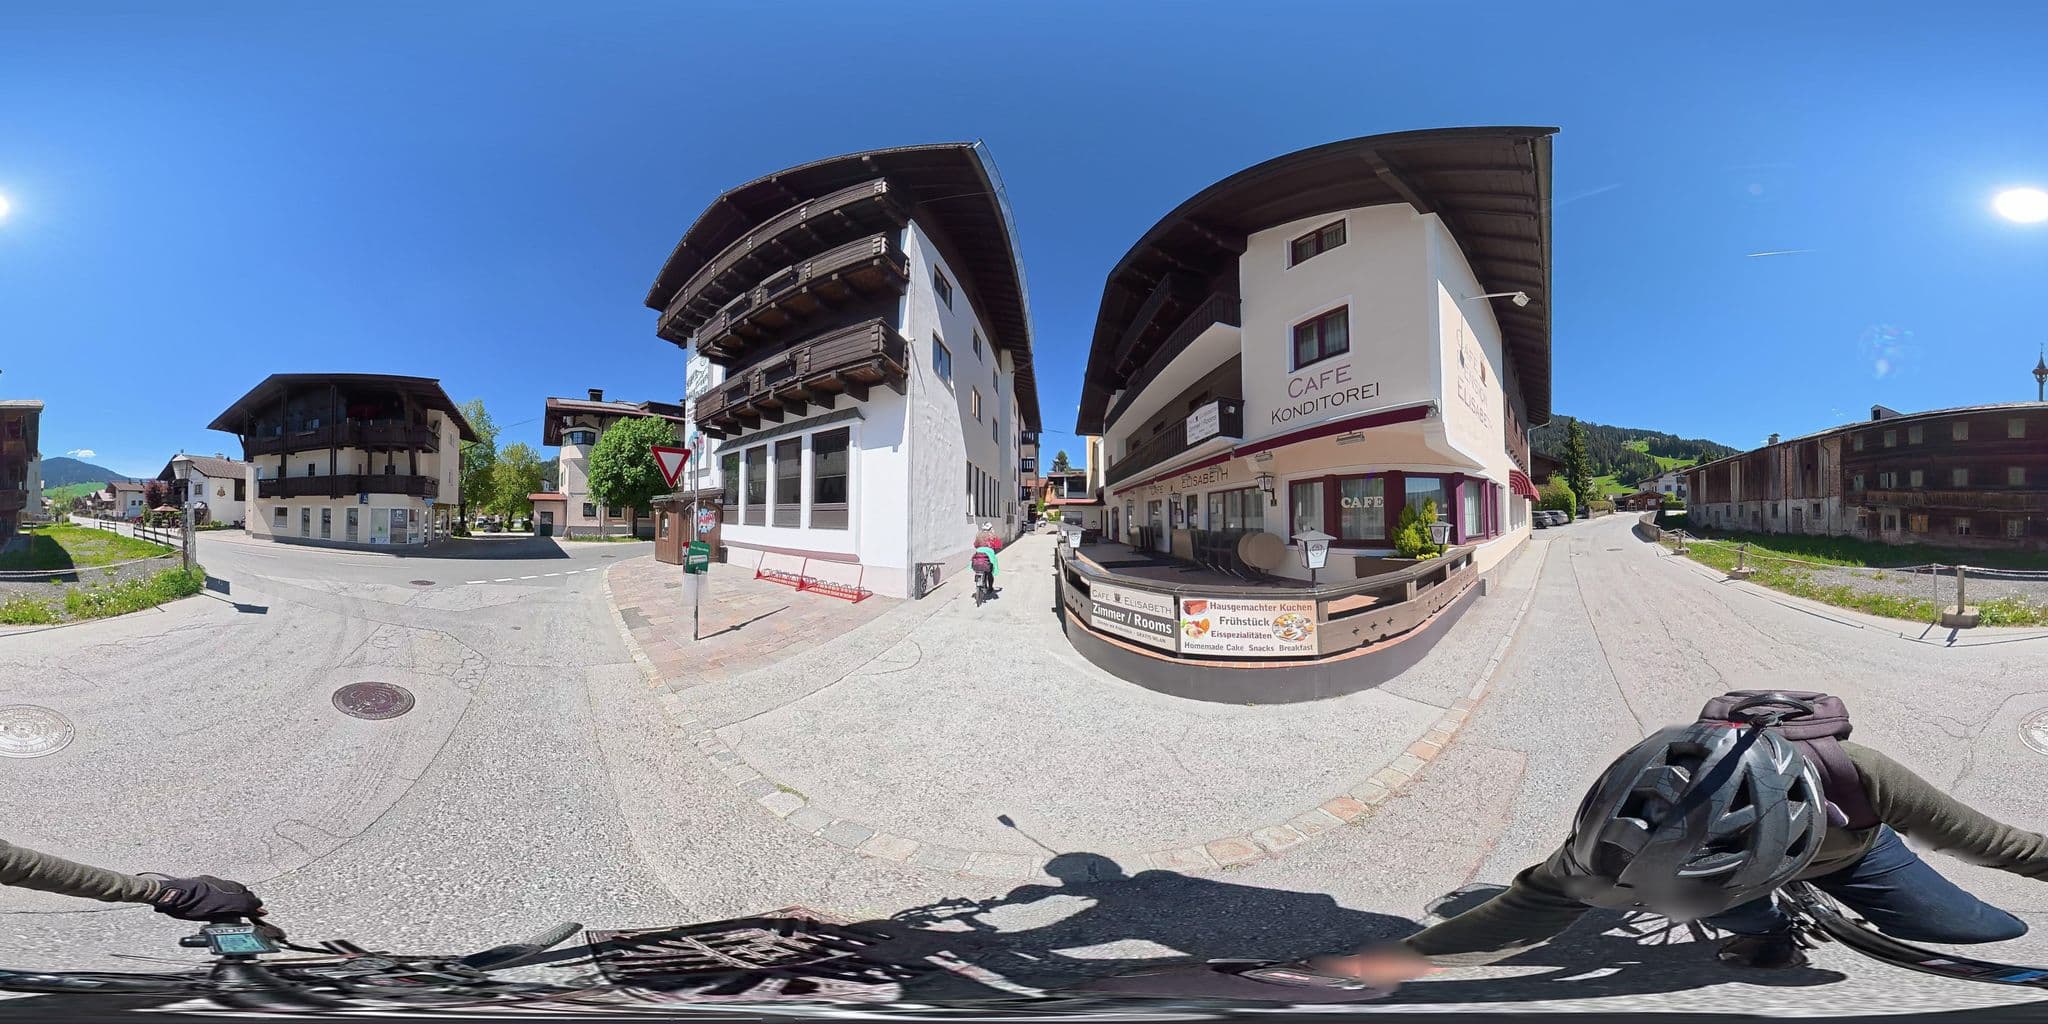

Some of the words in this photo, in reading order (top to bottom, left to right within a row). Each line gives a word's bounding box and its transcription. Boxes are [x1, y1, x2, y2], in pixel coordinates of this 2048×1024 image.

[1287, 364, 1352, 398] CAFE
[1271, 382, 1379, 424] KONDITOREI
[1341, 496, 1384, 509] CAFE
[1210, 601, 1276, 612] Hausgemachter
[1279, 602, 1312, 612] Kuchen
[1093, 602, 1126, 623] Zimmer
[1134, 613, 1172, 634] Rooms
[1219, 616, 1270, 627] Frühstück
[1211, 630, 1272, 640] Eisspezialitäten
[1184, 641, 1223, 651] Homemade
[1226, 643, 1244, 652] Cake
[1248, 644, 1274, 652] Snacks
[1279, 644, 1313, 652] Breakfast
